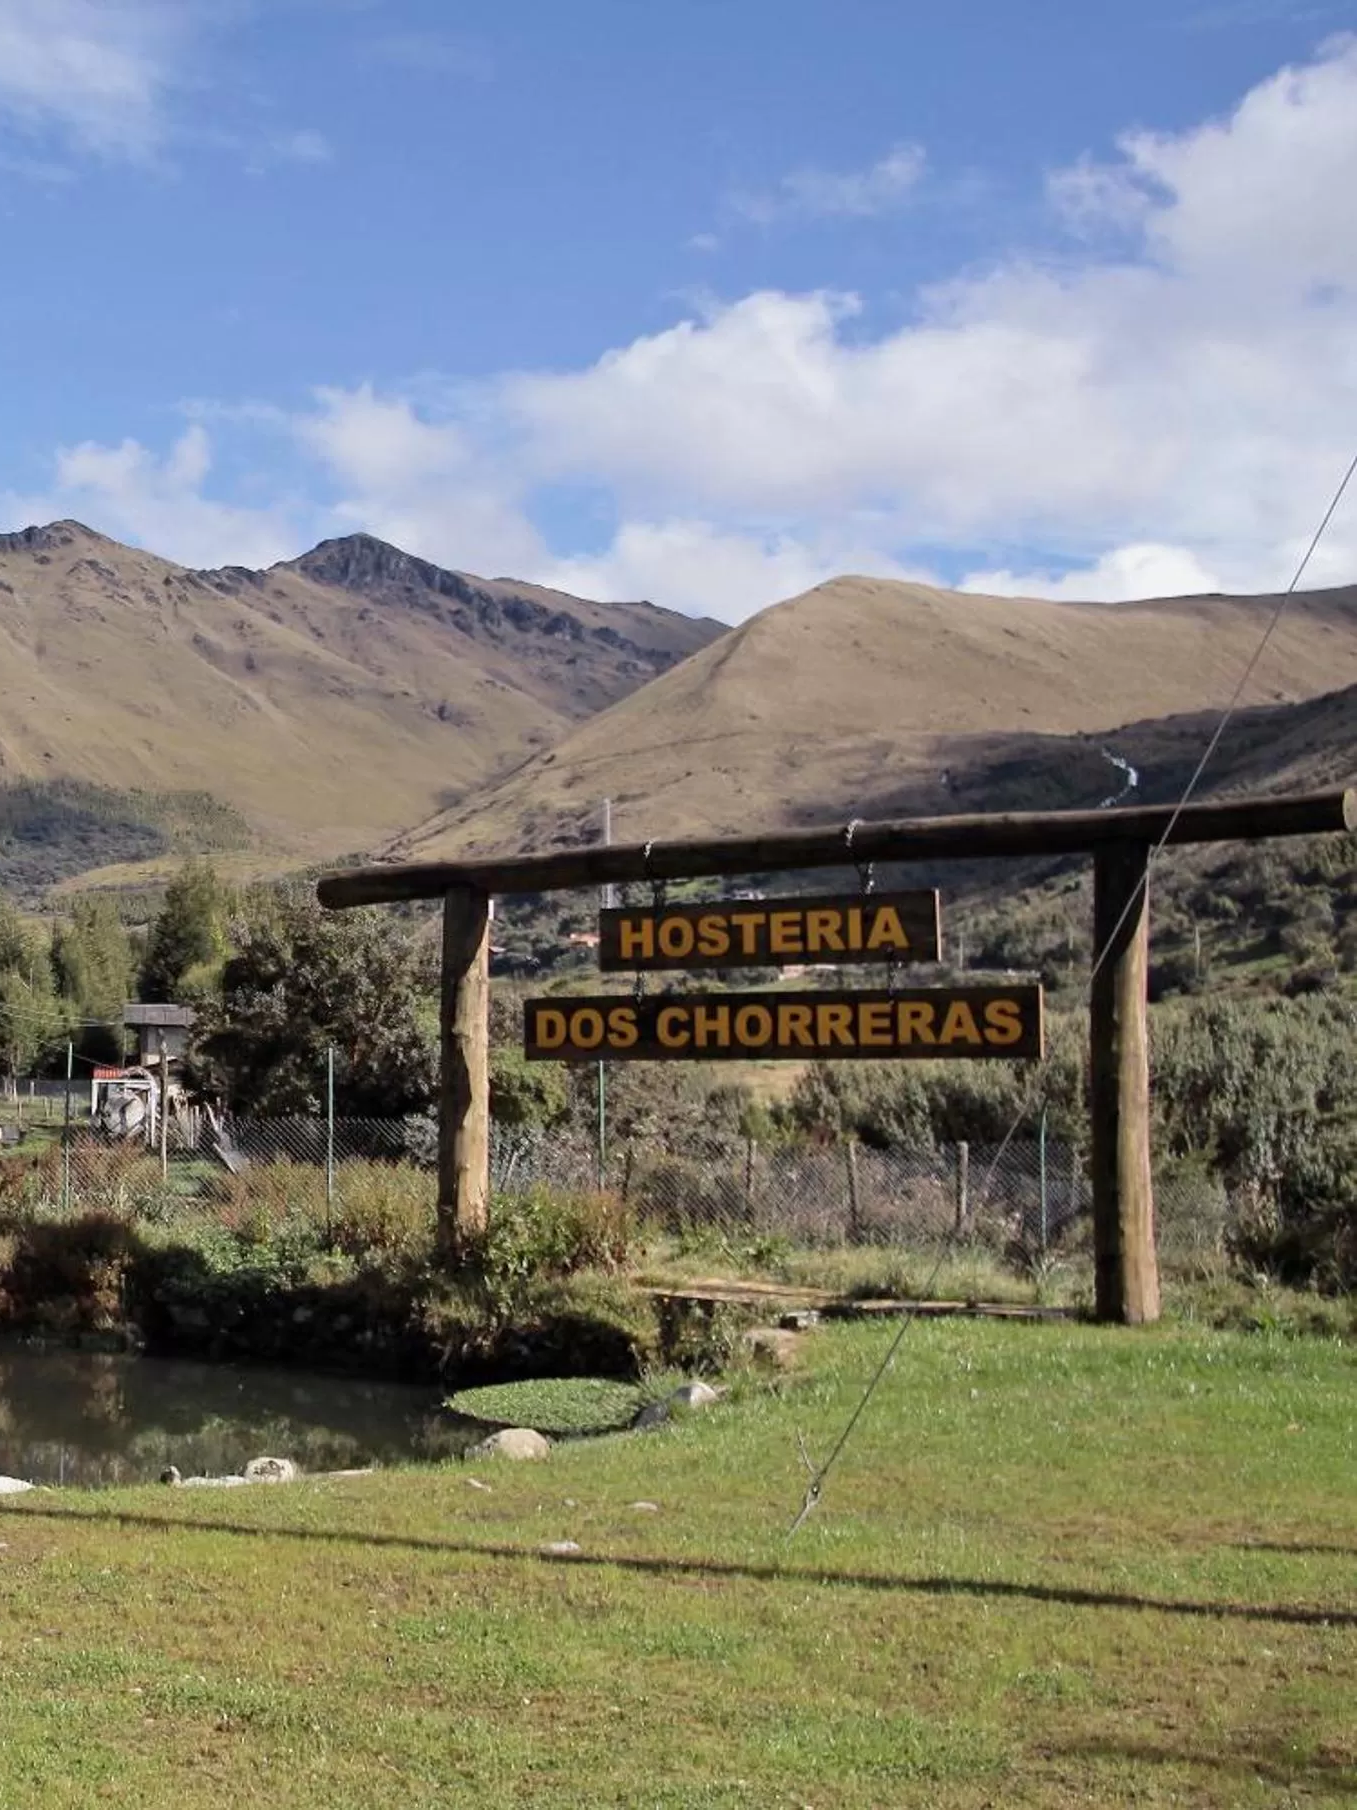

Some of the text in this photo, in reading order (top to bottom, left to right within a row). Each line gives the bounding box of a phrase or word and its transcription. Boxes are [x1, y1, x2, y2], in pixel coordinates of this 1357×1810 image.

[619, 906, 909, 959] HOSTERIA
[535, 1000, 1023, 1048] DOS CHORRERAS
